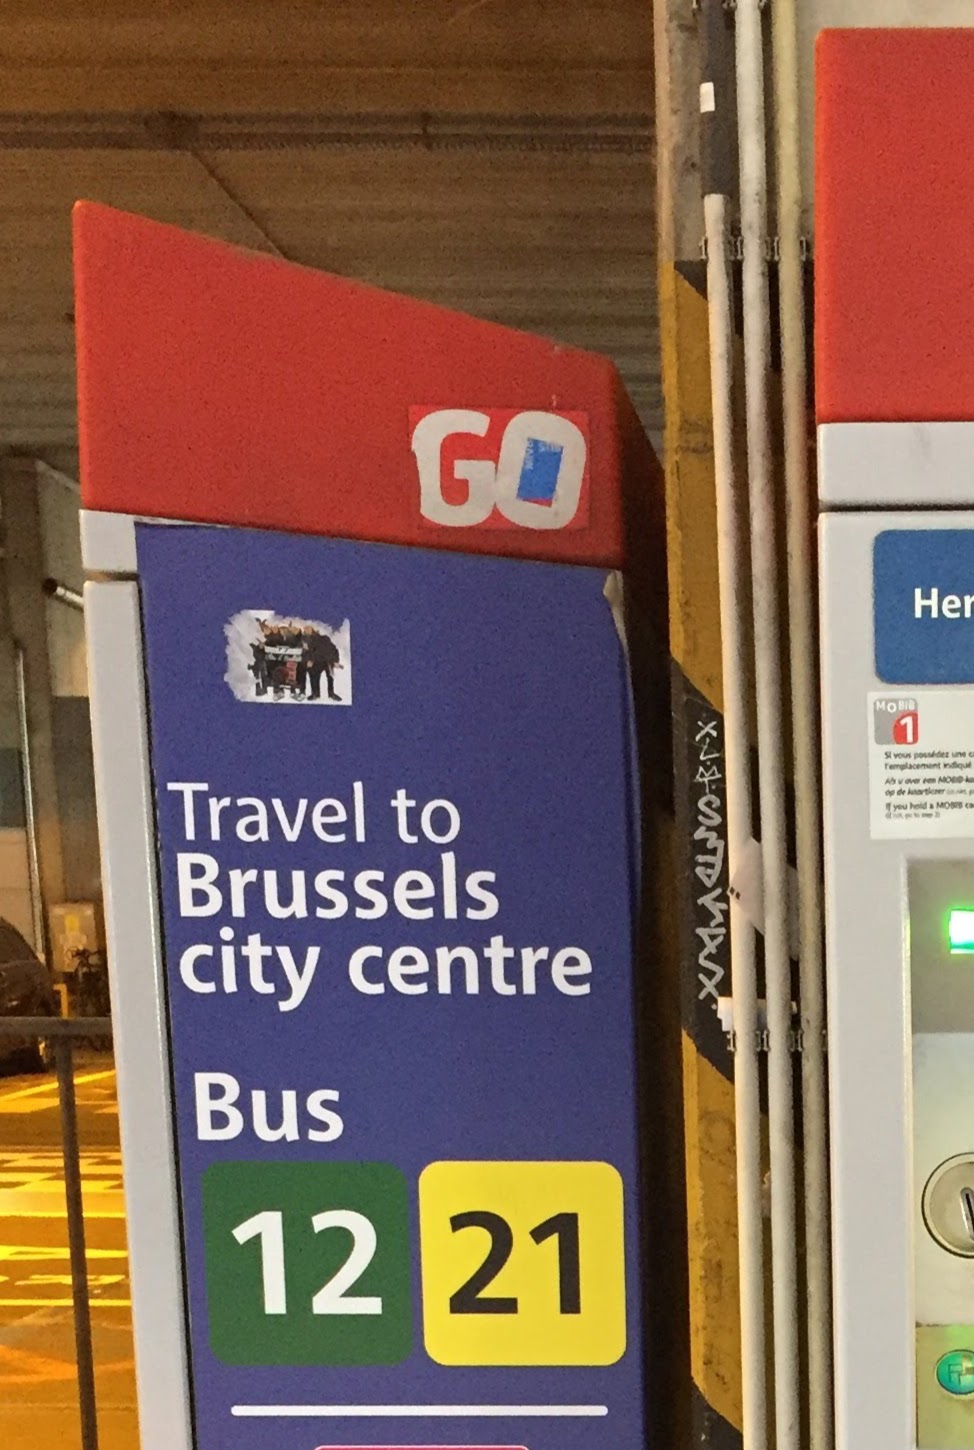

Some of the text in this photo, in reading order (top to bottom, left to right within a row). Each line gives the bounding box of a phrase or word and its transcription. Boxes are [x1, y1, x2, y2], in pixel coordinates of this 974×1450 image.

[411, 409, 586, 529] GO
[899, 715, 914, 742] 1
[167, 781, 460, 843] Travel to
[176, 851, 499, 920] Brussels
[179, 926, 592, 1012] city centre
[194, 1072, 344, 1142] Bus
[232, 1209, 382, 1314] 12
[449, 1210, 582, 1314] 21
